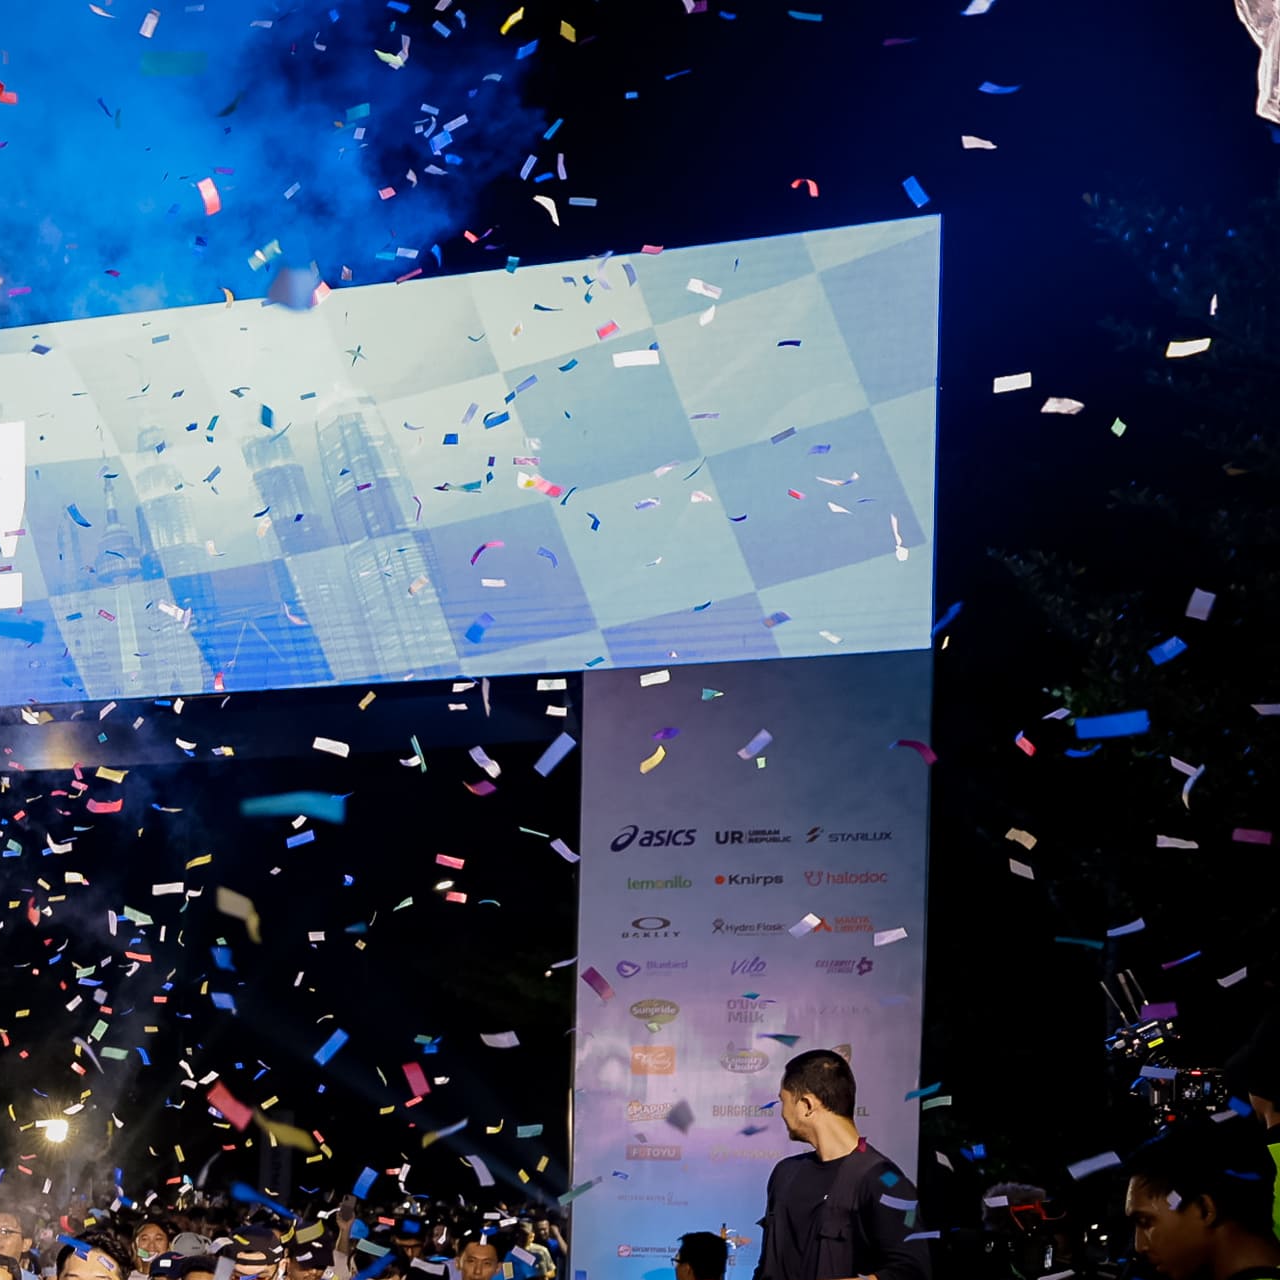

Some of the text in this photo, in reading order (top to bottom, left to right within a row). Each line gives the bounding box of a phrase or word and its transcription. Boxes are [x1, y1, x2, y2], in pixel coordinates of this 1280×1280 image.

[715, 831, 744, 844] UR
[828, 831, 893, 843] STARLUX
[627, 875, 693, 890] lemonilo
[728, 874, 784, 887] Knirps
[826, 871, 888, 885] halodoc
[725, 923, 755, 934] Hydro
[631, 1004, 677, 1017] Sunpride
[727, 1010, 765, 1023] Milk
[712, 1105, 774, 1117] BURGREENS
